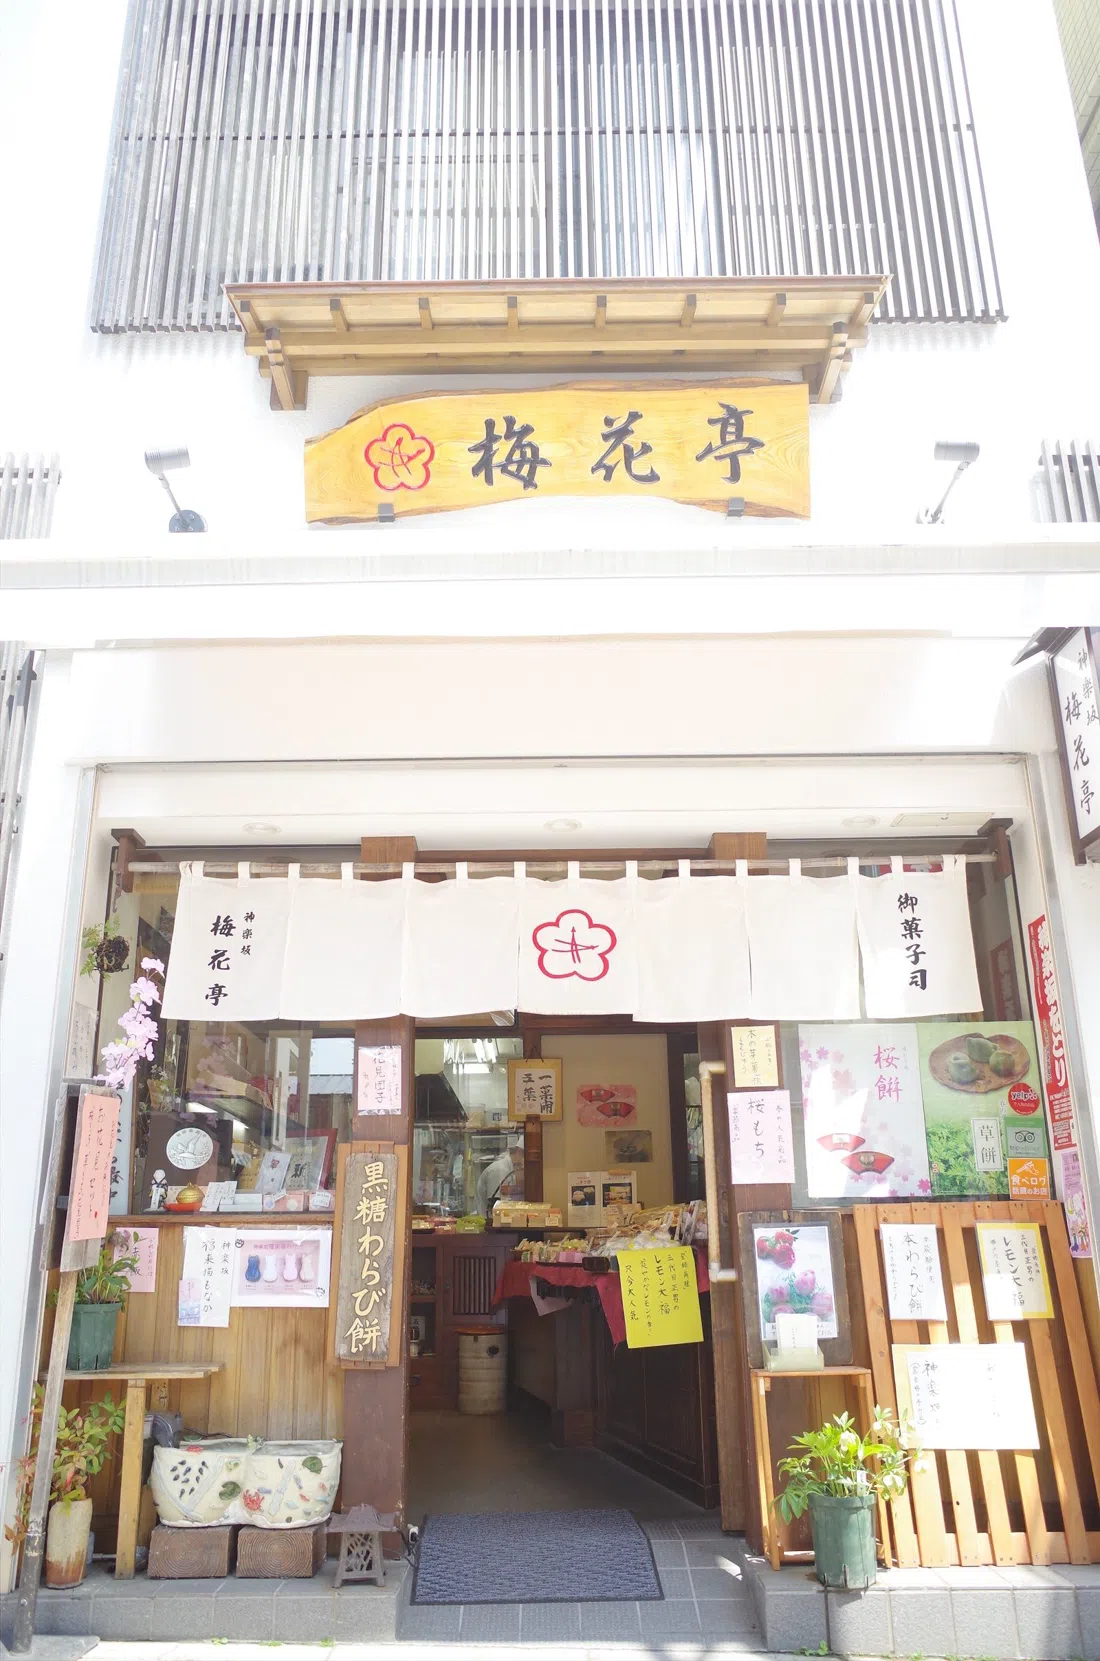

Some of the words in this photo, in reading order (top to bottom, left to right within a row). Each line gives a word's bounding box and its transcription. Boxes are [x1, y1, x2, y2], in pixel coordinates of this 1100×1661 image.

[467, 401, 765, 490] 梅花亭
[1078, 648, 1099, 726] 神楽坂
[1064, 692, 1095, 816] 梅花亭
[204, 914, 237, 1007] 梅花亭
[240, 911, 256, 956] 神楽坂
[897, 892, 927, 991] 御菓子司
[746, 1097, 765, 1158] 桜もち
[979, 1124, 997, 1165] 草餅
[221, 1240, 232, 1275] 神楽坂
[345, 1160, 389, 1353] 黒糖わらび餅
[624, 1265, 639, 1321] 只今大人気
[653, 1254, 671, 1316] レモン大福
[901, 1231, 924, 1316] 本わらび餅
[1002, 1235, 1025, 1307] レモン大福
